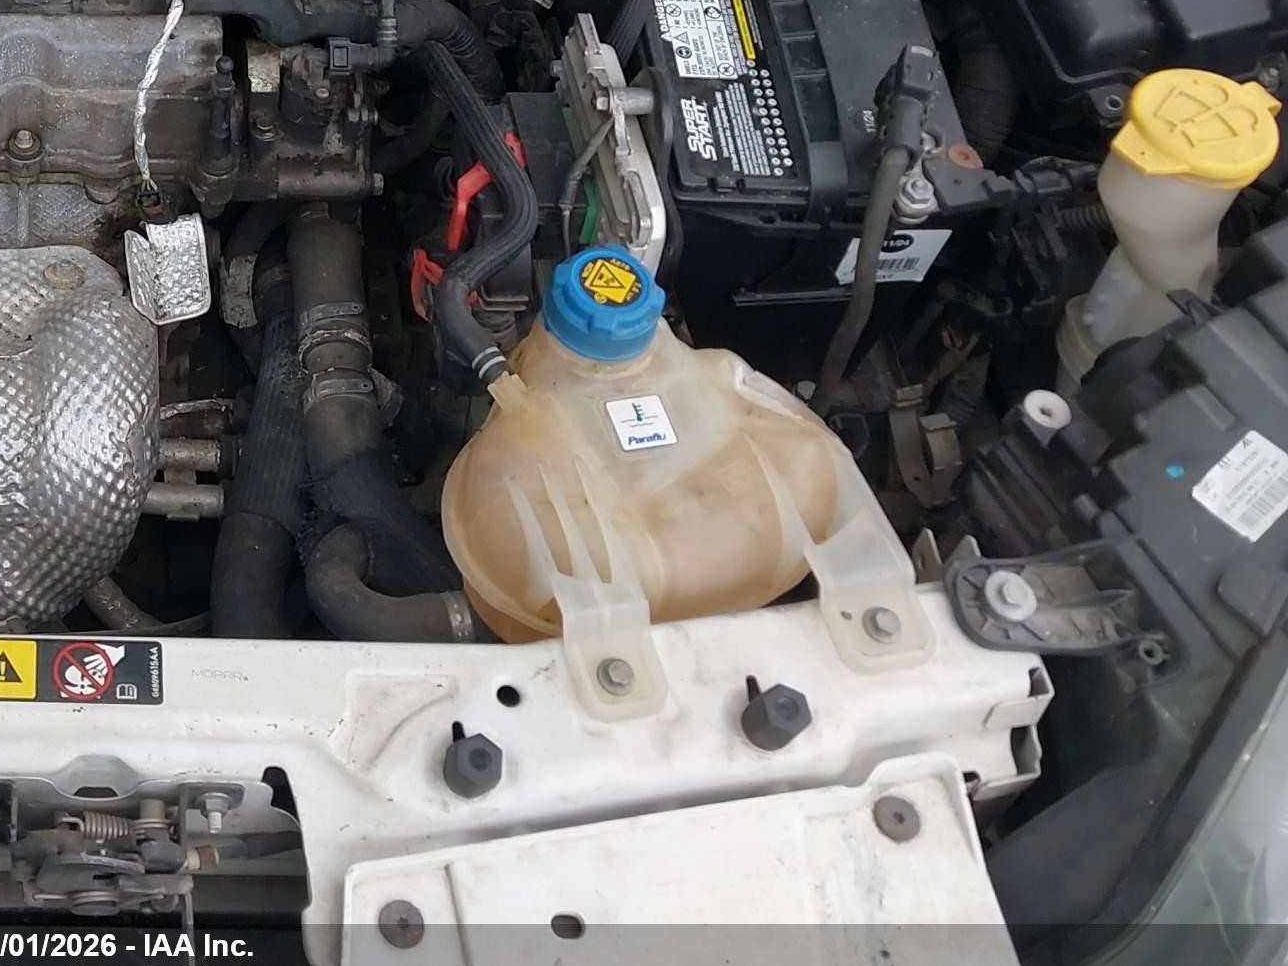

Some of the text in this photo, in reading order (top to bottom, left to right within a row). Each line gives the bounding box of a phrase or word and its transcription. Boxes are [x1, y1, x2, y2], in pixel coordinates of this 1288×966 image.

[680, 98, 698, 152] SUPER
[693, 100, 718, 161] START
[628, 432, 666, 445] Paraflu
